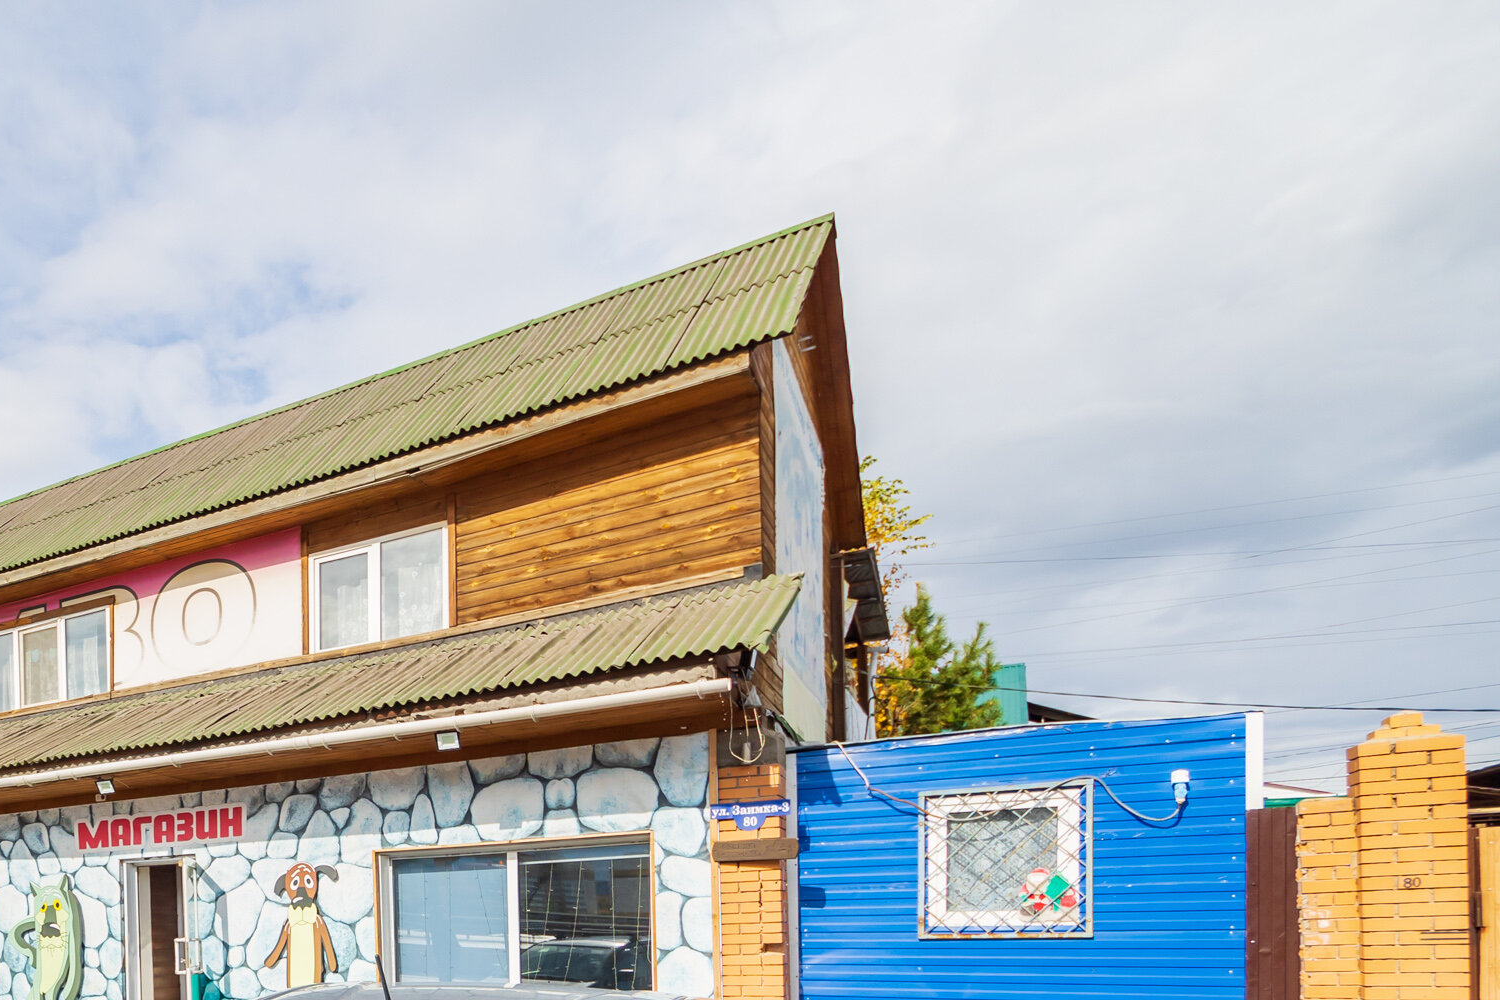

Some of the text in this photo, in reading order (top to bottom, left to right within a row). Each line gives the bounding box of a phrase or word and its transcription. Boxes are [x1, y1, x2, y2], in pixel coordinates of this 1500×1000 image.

[711, 802, 790, 819] ул. Заимка-3
[77, 805, 243, 850] МАГАЗИН
[743, 817, 758, 827] 80
[1403, 877, 1421, 888] 80
